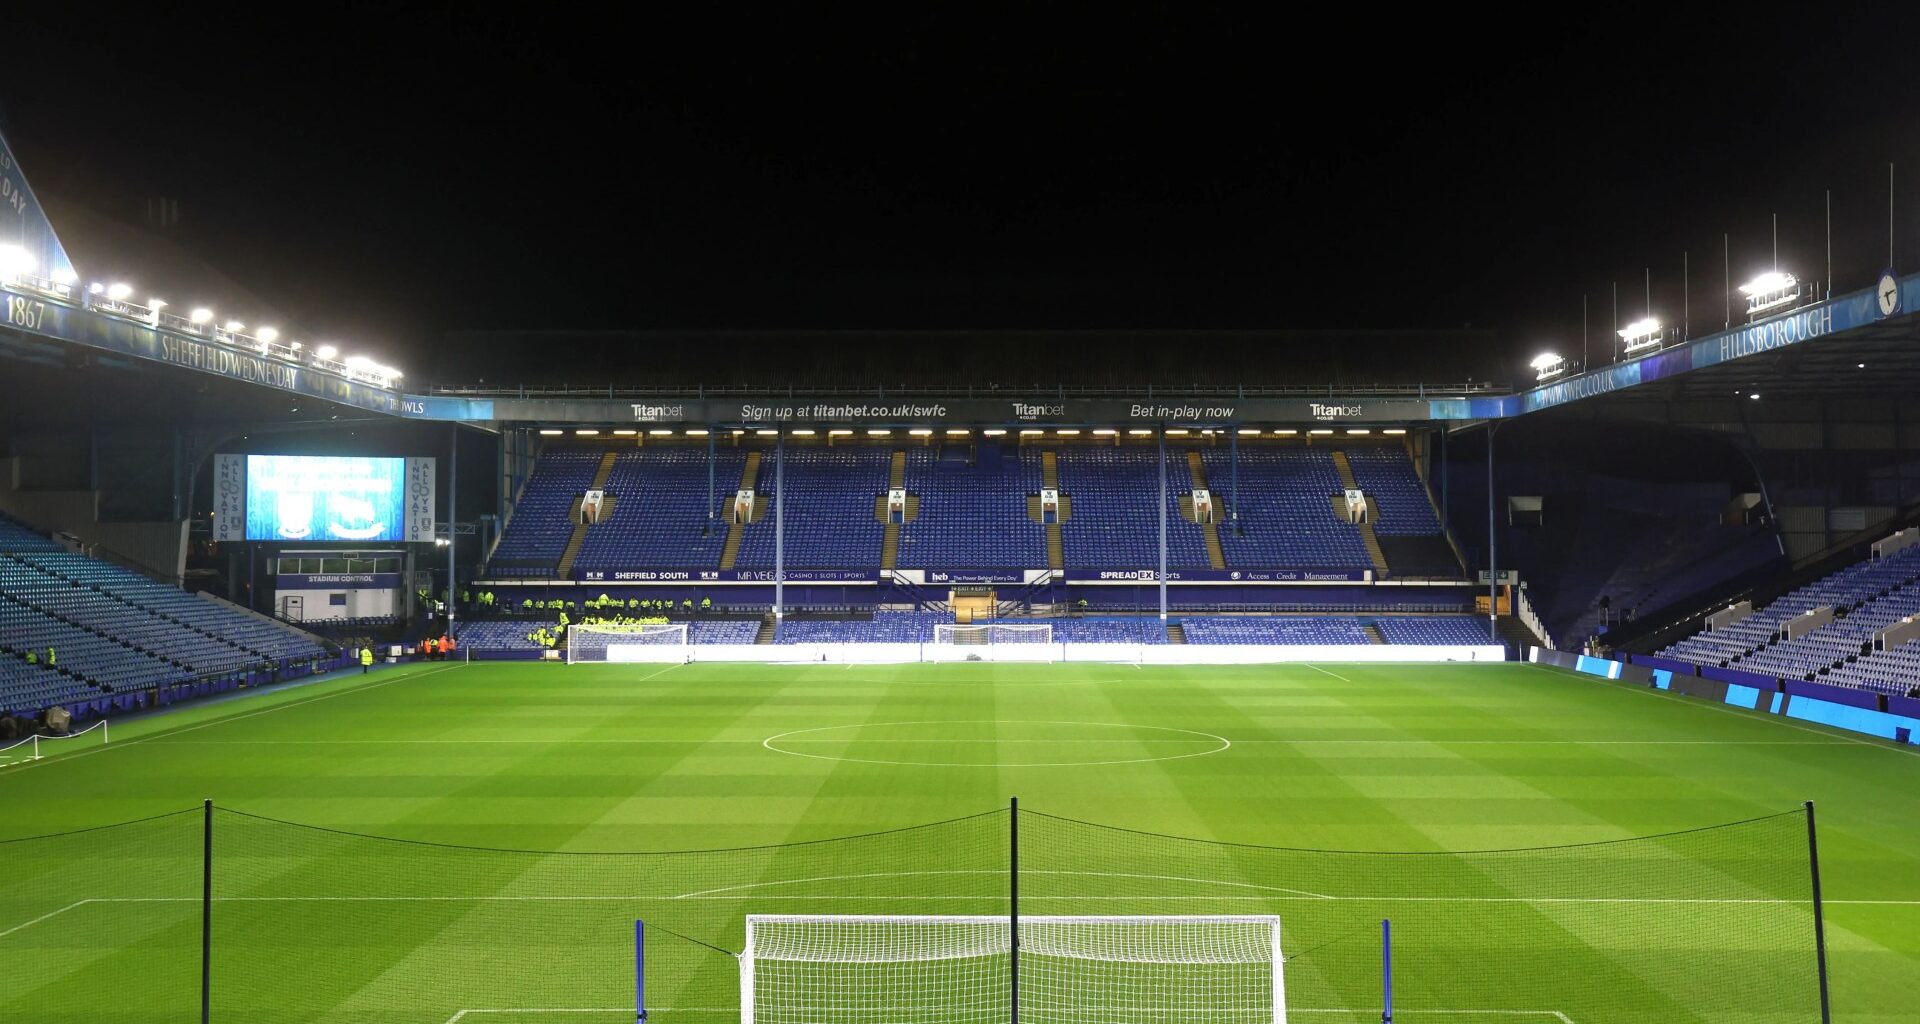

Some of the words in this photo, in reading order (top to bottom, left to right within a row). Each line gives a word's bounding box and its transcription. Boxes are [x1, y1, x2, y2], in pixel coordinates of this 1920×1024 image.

[6, 294, 45, 330] 1867
[1720, 305, 1833, 361] HILLSBOROUGH
[161, 335, 229, 373] SHEFFIELD
[230, 353, 298, 389] WEDNESDAY
[400, 400, 424, 414] OWLS
[631, 403, 683, 416] Titanbet
[741, 404, 772, 420] Sign
[775, 407, 793, 420] up
[796, 406, 810, 417] at
[813, 404, 946, 417] titanbet.co.uk/swfc
[1012, 403, 1065, 416] Titanbet
[1130, 404, 1154, 417] Bet
[1157, 404, 1202, 420] in-play
[1205, 407, 1234, 417] now
[1309, 403, 1362, 416] Titanbet
[229, 460, 240, 512] ALLOYS
[420, 463, 430, 513] ALLOYS
[220, 456, 231, 540] INNOVATION
[411, 458, 421, 540] INNOVATION
[308, 575, 340, 583] STADIUM
[737, 571, 752, 580] MR
[1100, 571, 1154, 580] SPREADEX
[1247, 572, 1270, 580] Access
[1276, 572, 1297, 580] Credit
[1304, 572, 1348, 581] Management
